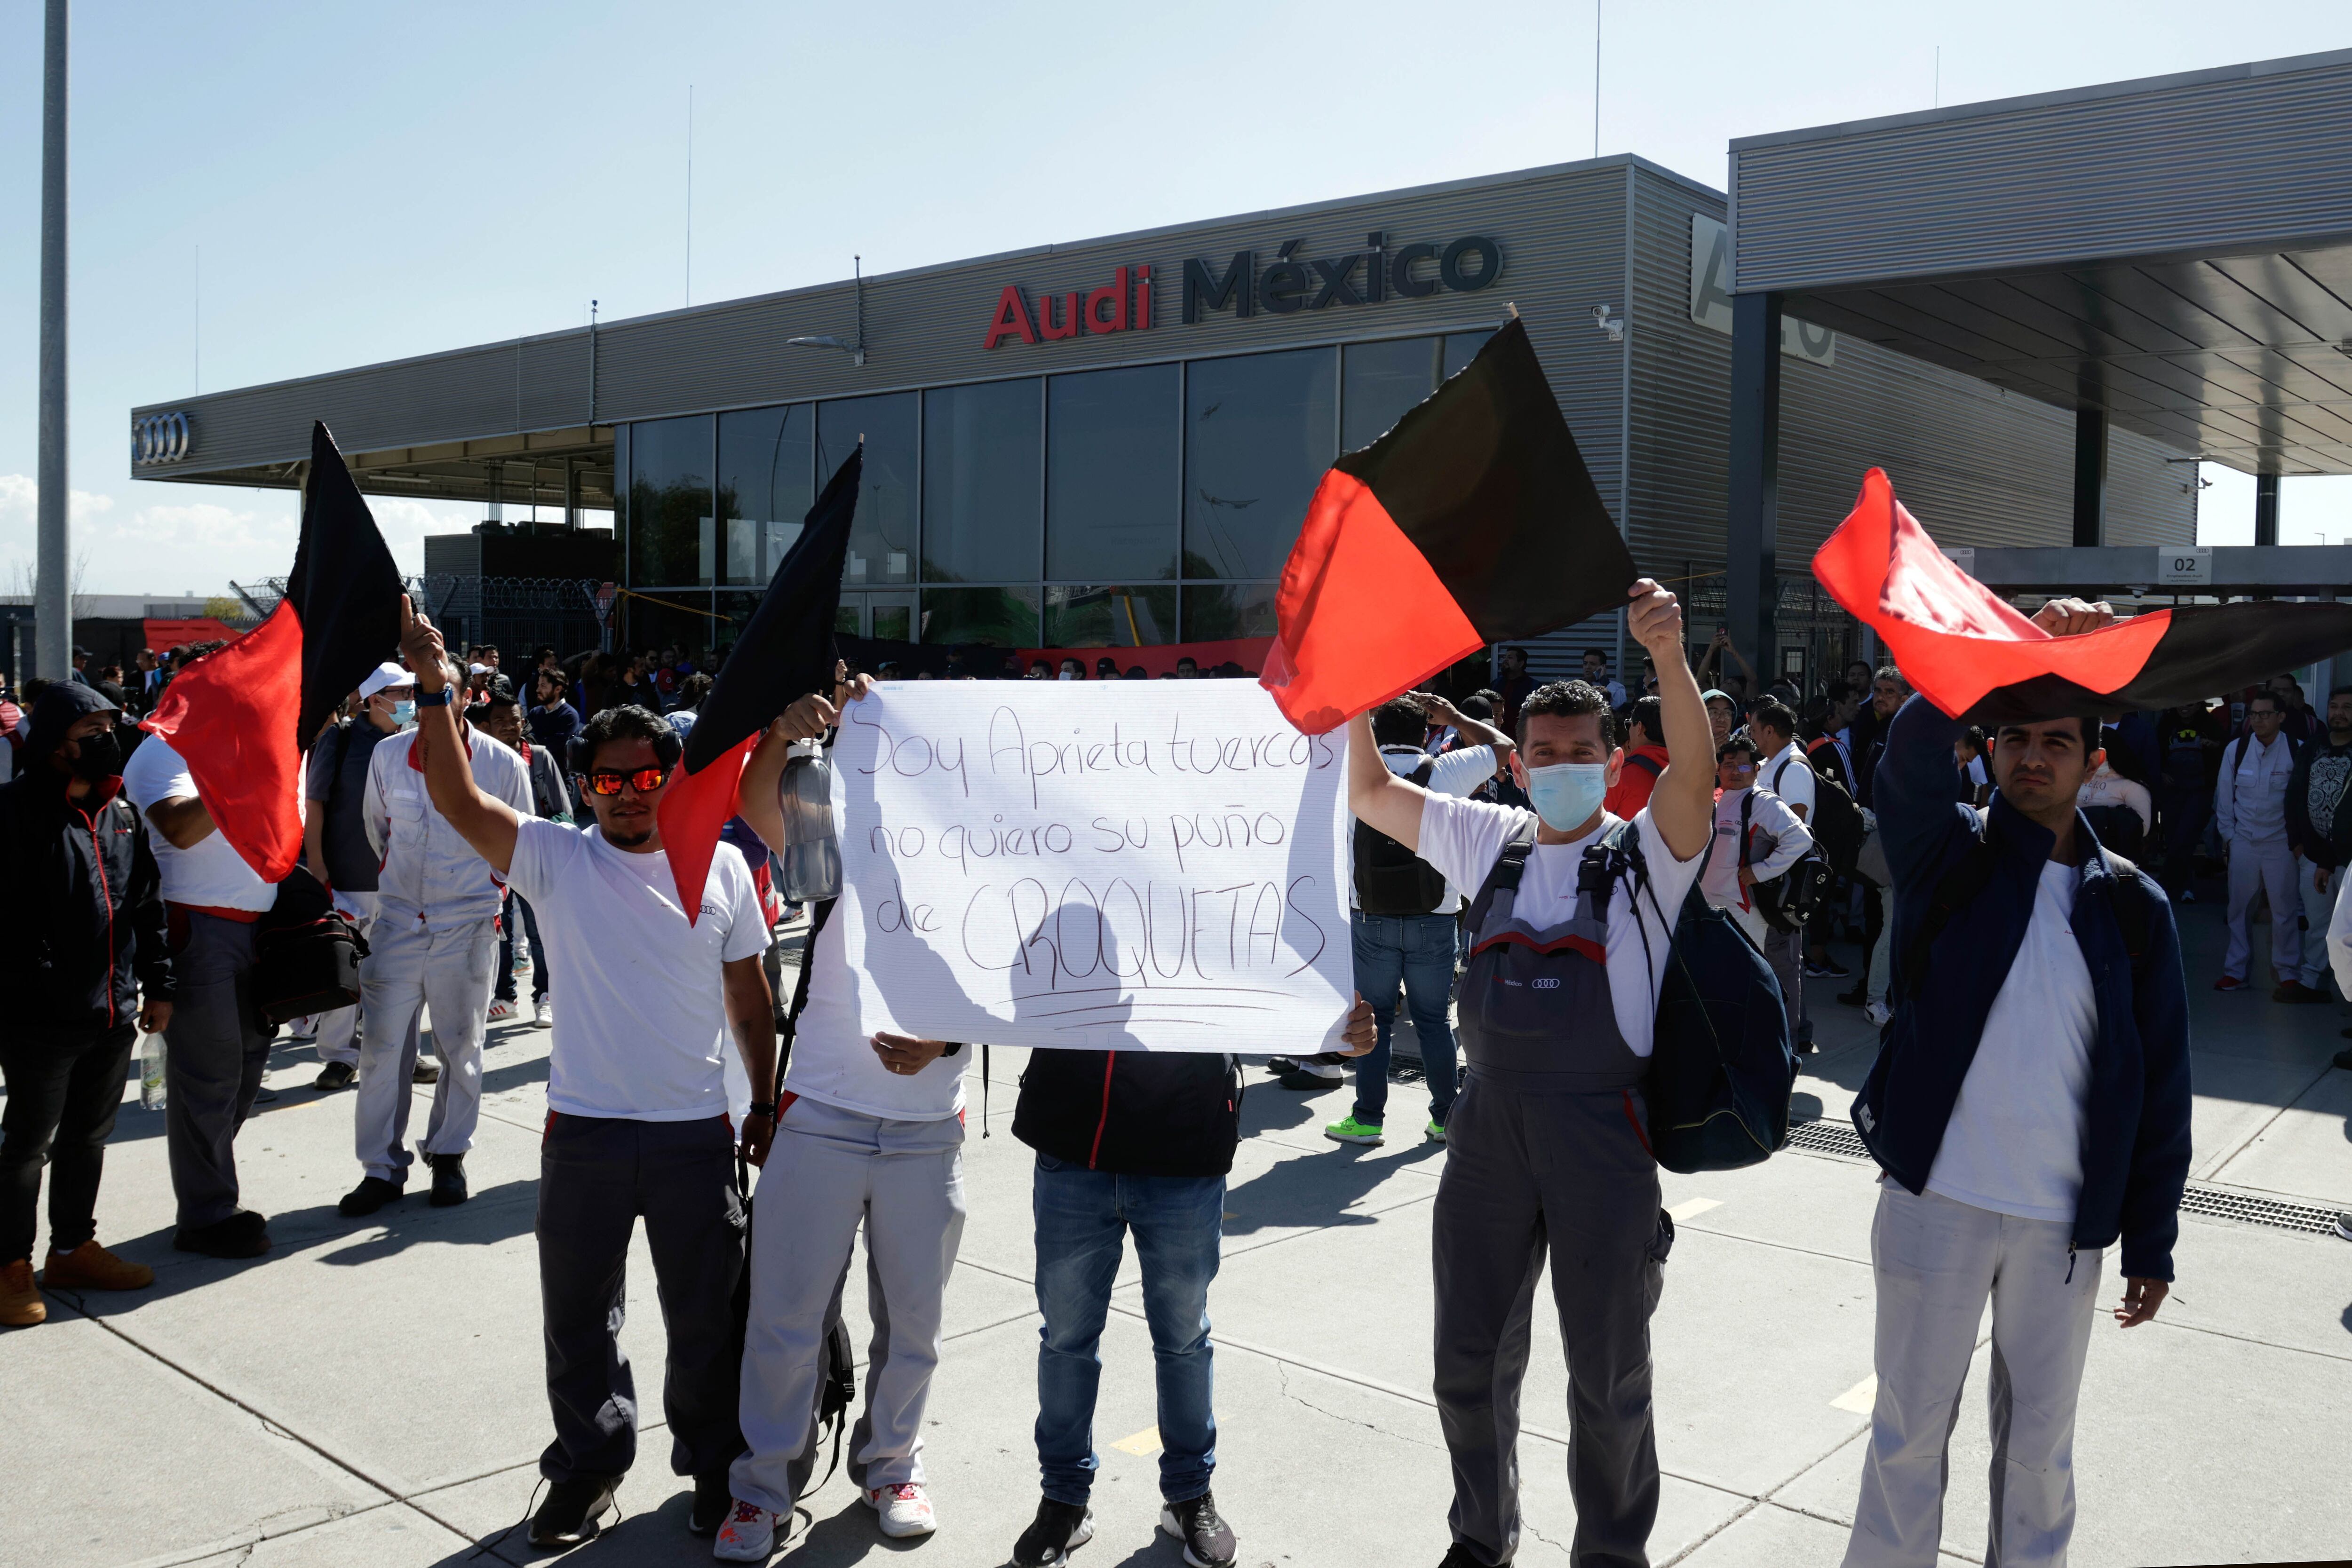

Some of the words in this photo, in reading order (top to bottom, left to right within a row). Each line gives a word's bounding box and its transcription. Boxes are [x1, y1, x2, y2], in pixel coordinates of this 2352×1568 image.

[983, 264, 1154, 349] Audi
[1182, 230, 1506, 325] México
[2175, 558, 2195, 571] 02
[851, 703, 969, 798] Soy
[989, 705, 1160, 810] Aprieta
[1166, 711, 1335, 773] tuercas
[868, 825, 925, 858] no
[939, 814, 1073, 876] quiero
[1092, 816, 1148, 852] su
[1170, 805, 1285, 873] puño
[877, 879, 943, 934] de
[962, 875, 1325, 990] CROQUETAS
